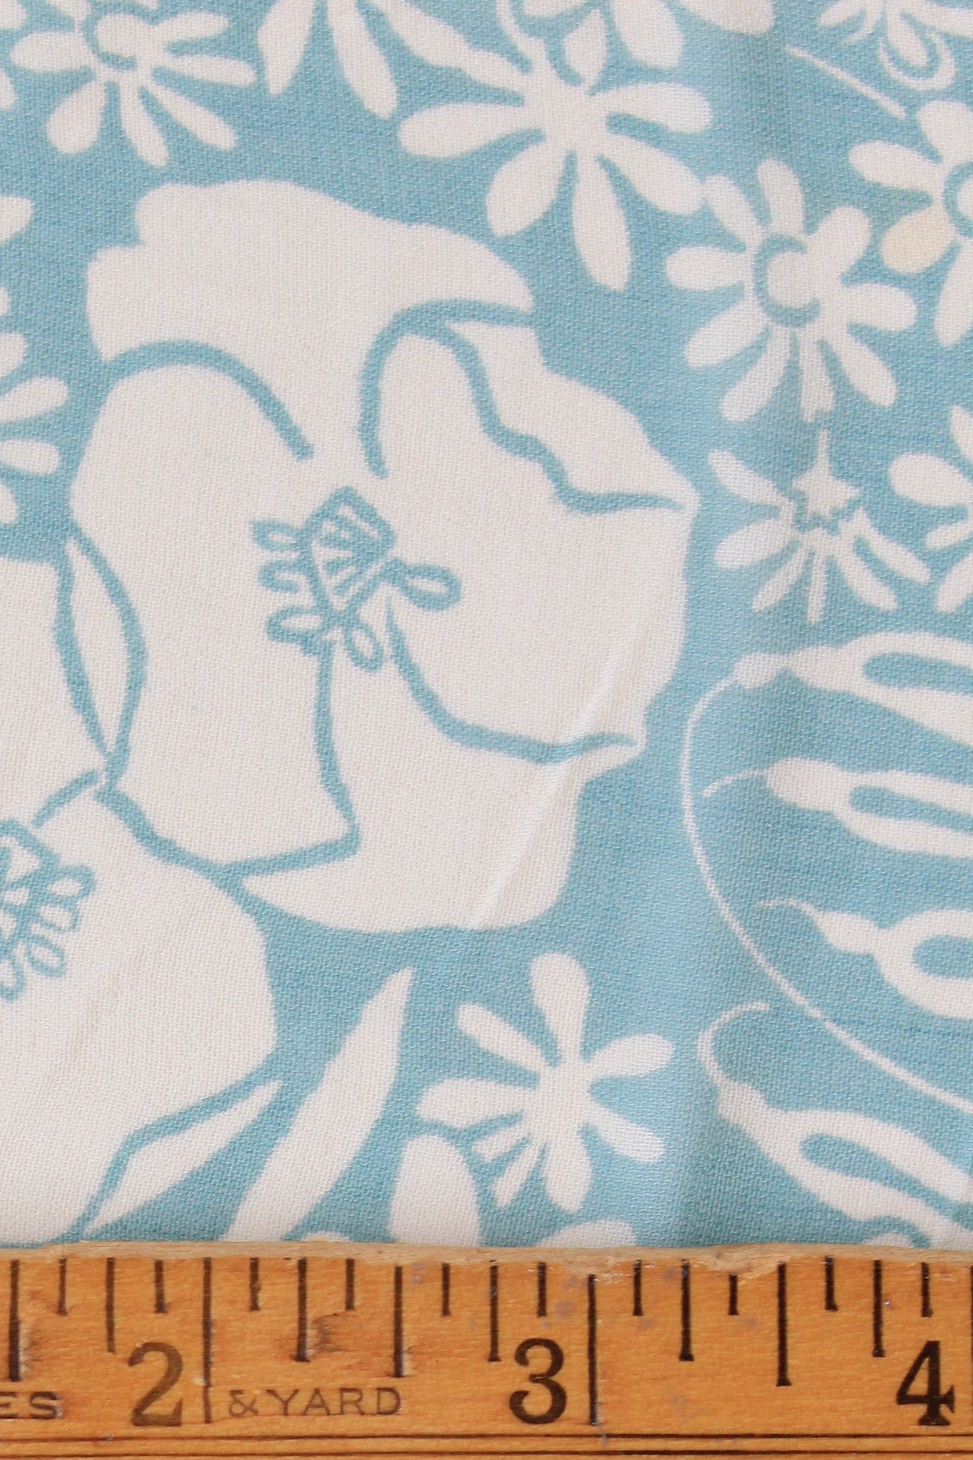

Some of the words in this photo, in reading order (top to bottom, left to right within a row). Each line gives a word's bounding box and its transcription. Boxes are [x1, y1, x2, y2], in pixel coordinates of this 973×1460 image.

[126, 1341, 184, 1426] 2
[508, 1338, 568, 1425] 3
[895, 1340, 956, 1426] 4
